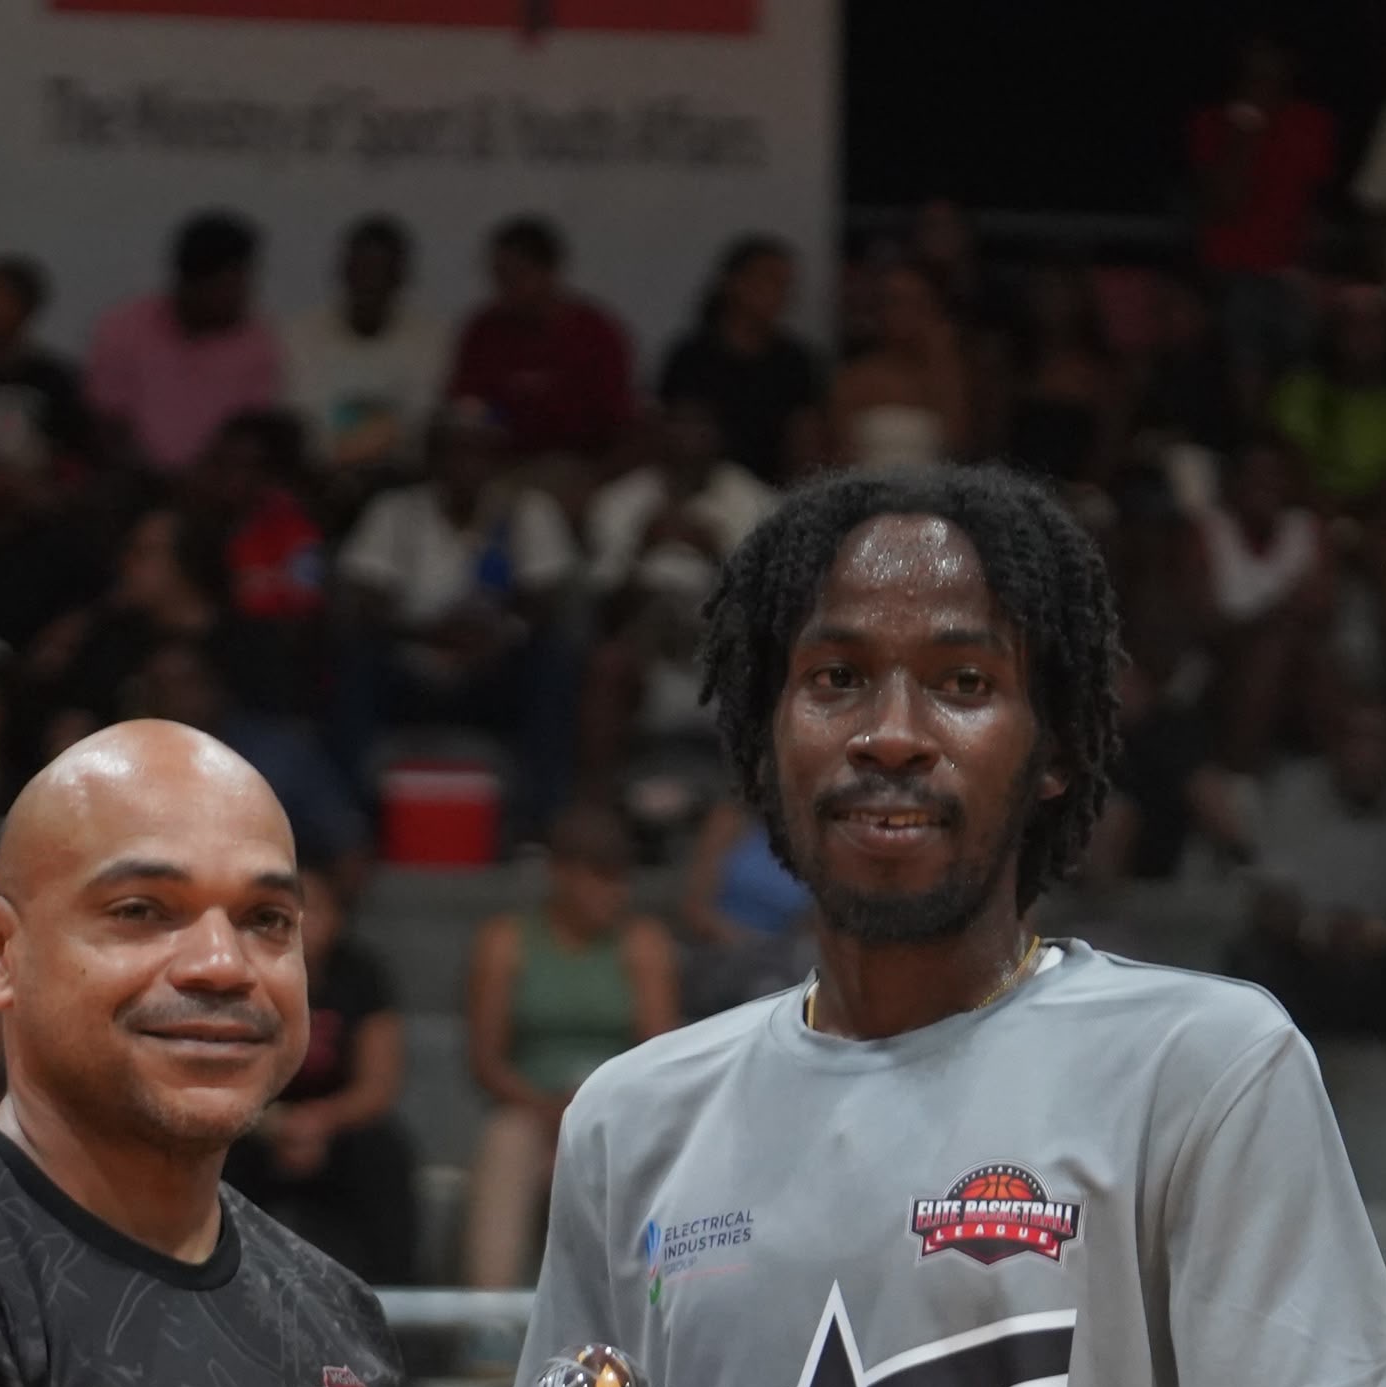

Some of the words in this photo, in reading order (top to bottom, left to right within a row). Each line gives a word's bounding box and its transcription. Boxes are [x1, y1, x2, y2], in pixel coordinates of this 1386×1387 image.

[131, 80, 299, 166] Ministry
[355, 98, 455, 170] Sport
[663, 1209, 754, 1243] ELECTRICAL
[916, 1200, 962, 1230] ELITE
[963, 1200, 1075, 1237] BASKETBALL
[935, 1223, 1049, 1246] LEAGUE
[663, 1226, 752, 1261] INDUSTRIES
